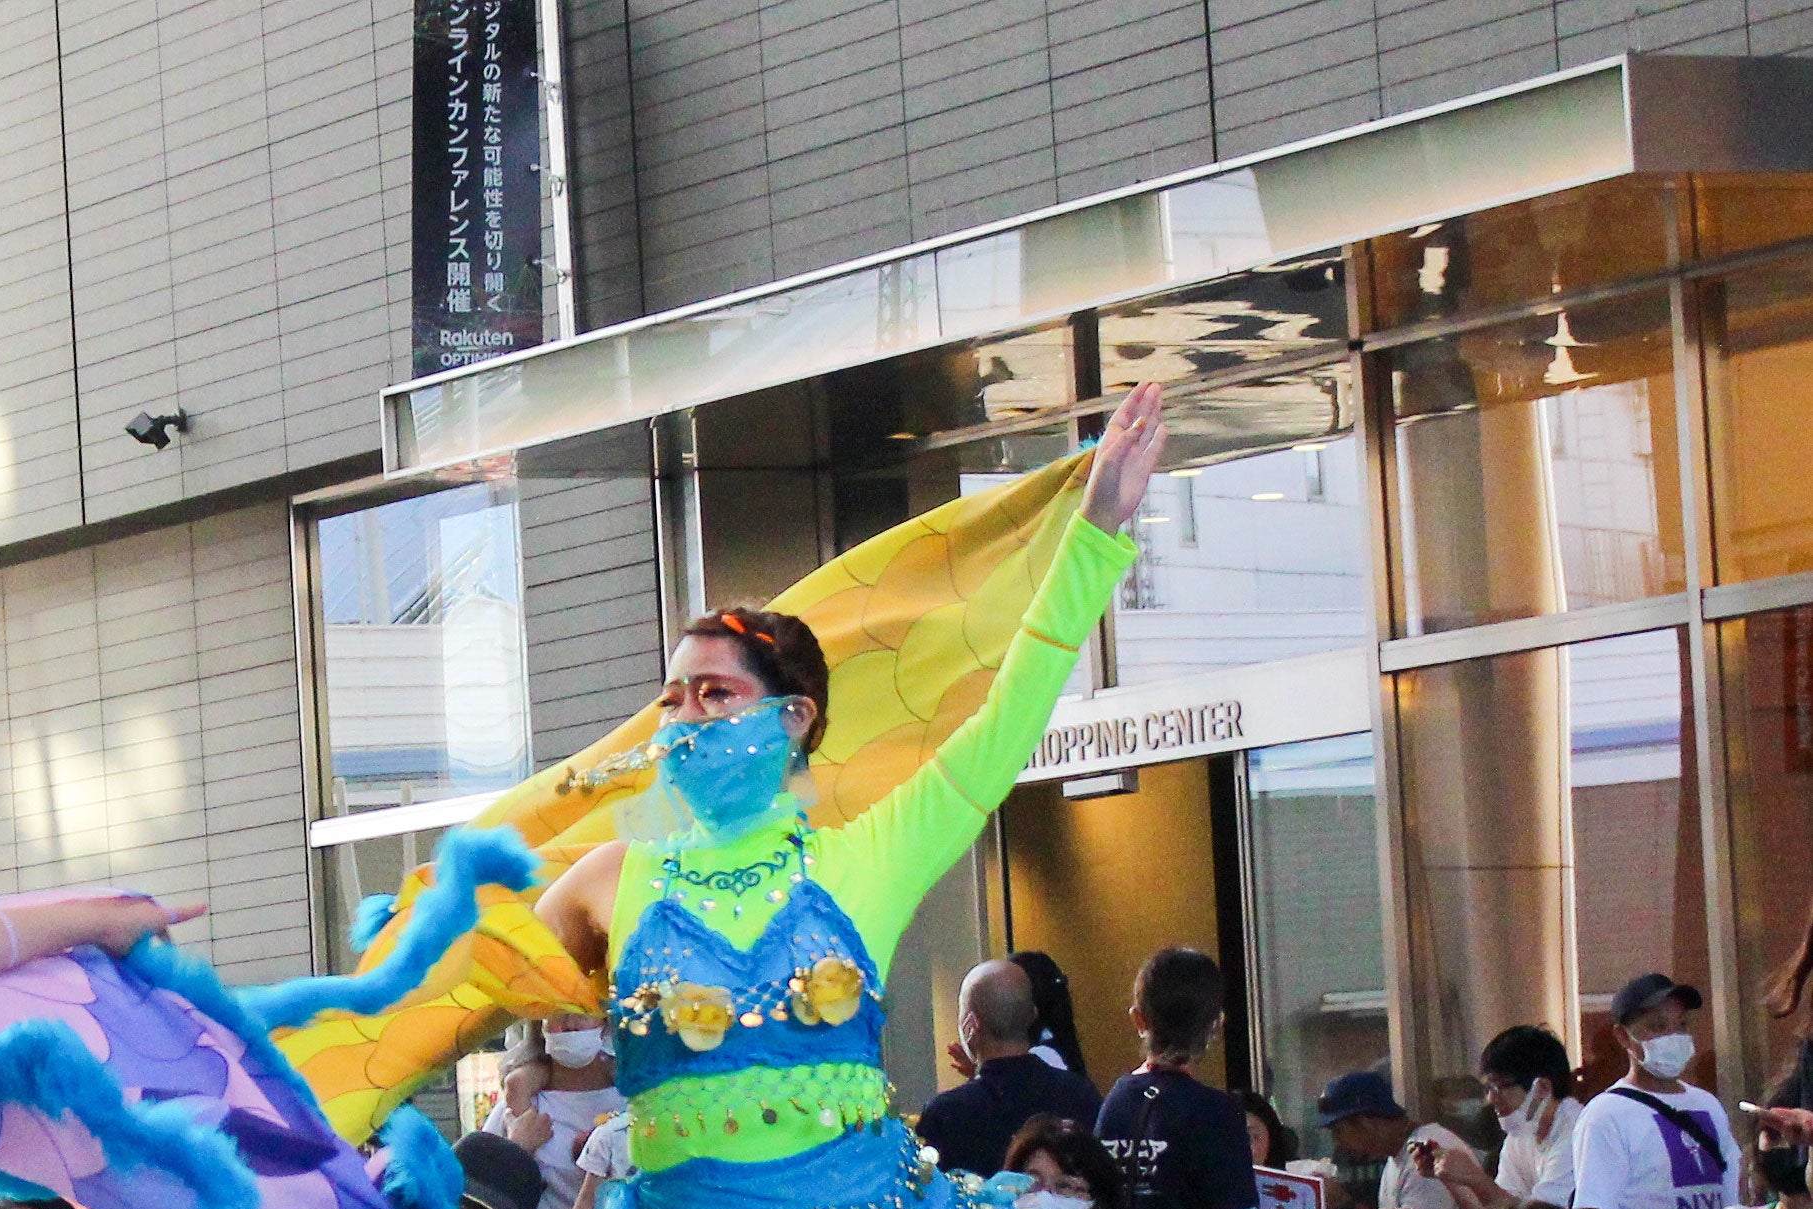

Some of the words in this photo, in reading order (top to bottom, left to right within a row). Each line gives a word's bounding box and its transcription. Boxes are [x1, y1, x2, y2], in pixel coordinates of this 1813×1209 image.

[447, 0, 472, 313] ンラインカンファレンス開催
[439, 329, 514, 346] Rakuten
[1026, 717, 1137, 770] HOPPING
[1142, 700, 1244, 750] CENTER
